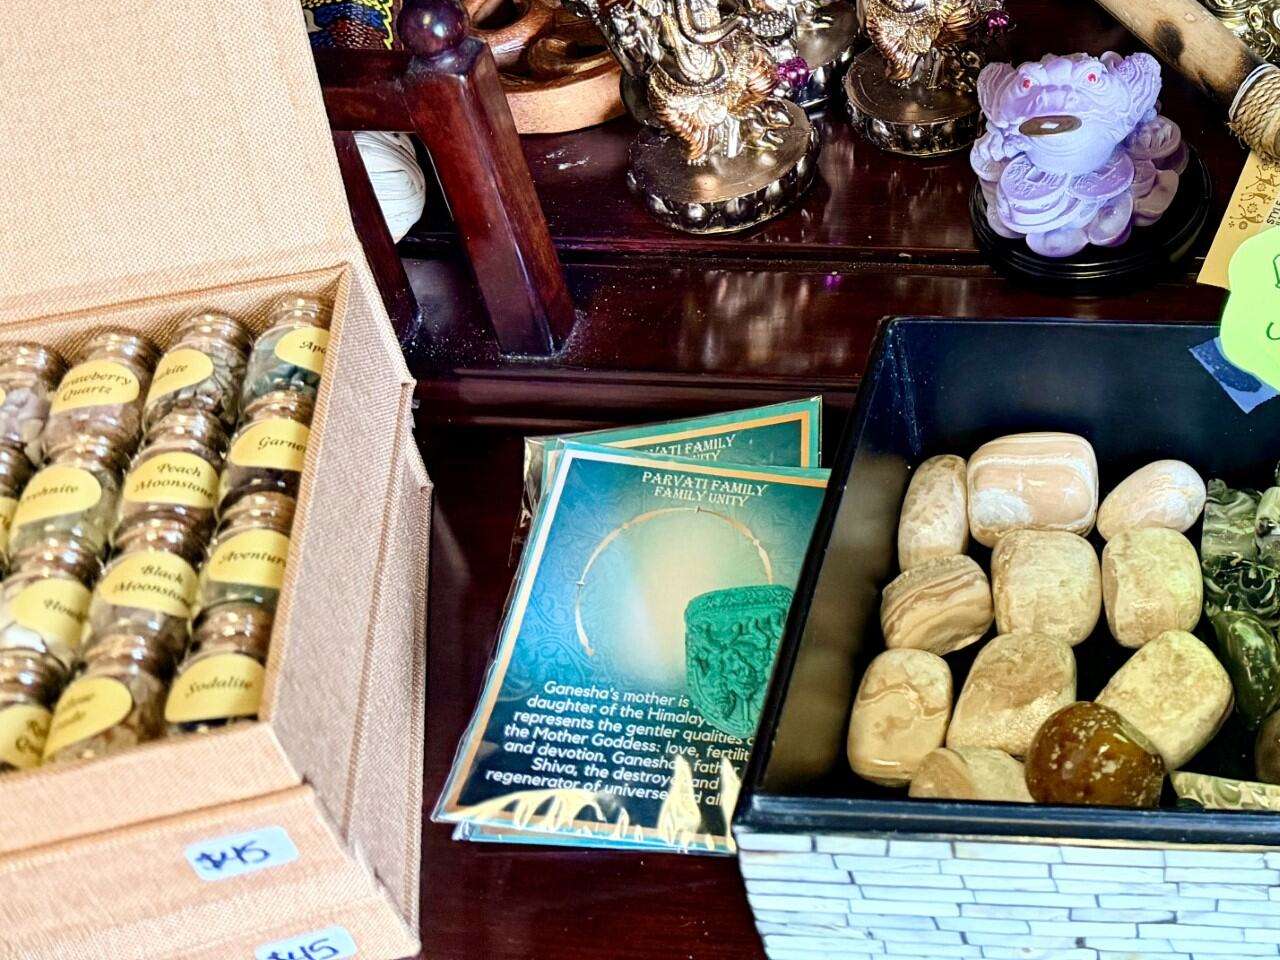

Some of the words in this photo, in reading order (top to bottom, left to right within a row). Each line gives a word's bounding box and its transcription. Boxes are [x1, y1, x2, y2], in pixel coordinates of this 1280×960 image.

[685, 434, 736, 454] FAMILY
[157, 463, 202, 477] Peach
[642, 471, 708, 490] PARVATI
[710, 479, 769, 497] FAMILY
[654, 485, 708, 502] FAMILY
[708, 492, 750, 508] UNITY
[141, 564, 184, 584] Black
[544, 680, 620, 701] Ganesha's
[624, 690, 676, 707] mother
[678, 695, 690, 708] is
[526, 694, 598, 714] daughter
[599, 703, 618, 716] of
[620, 704, 645, 719] the
[648, 707, 713, 728] Himalay
[513, 711, 595, 730] represents
[598, 718, 623, 733] the
[626, 722, 681, 740] gentler
[503, 741, 536, 755] and
[537, 743, 608, 763] devotion.
[504, 723, 530, 738] the
[532, 726, 589, 745] Mother
[591, 733, 662, 753] Goddess:
[666, 741, 700, 758] love,
[707, 744, 751, 762] fertilit
[485, 770, 582, 790] regenerator
[583, 780, 603, 793] of
[530, 757, 578, 777] Shiva,
[584, 764, 610, 779] the
[692, 777, 720, 790] and
